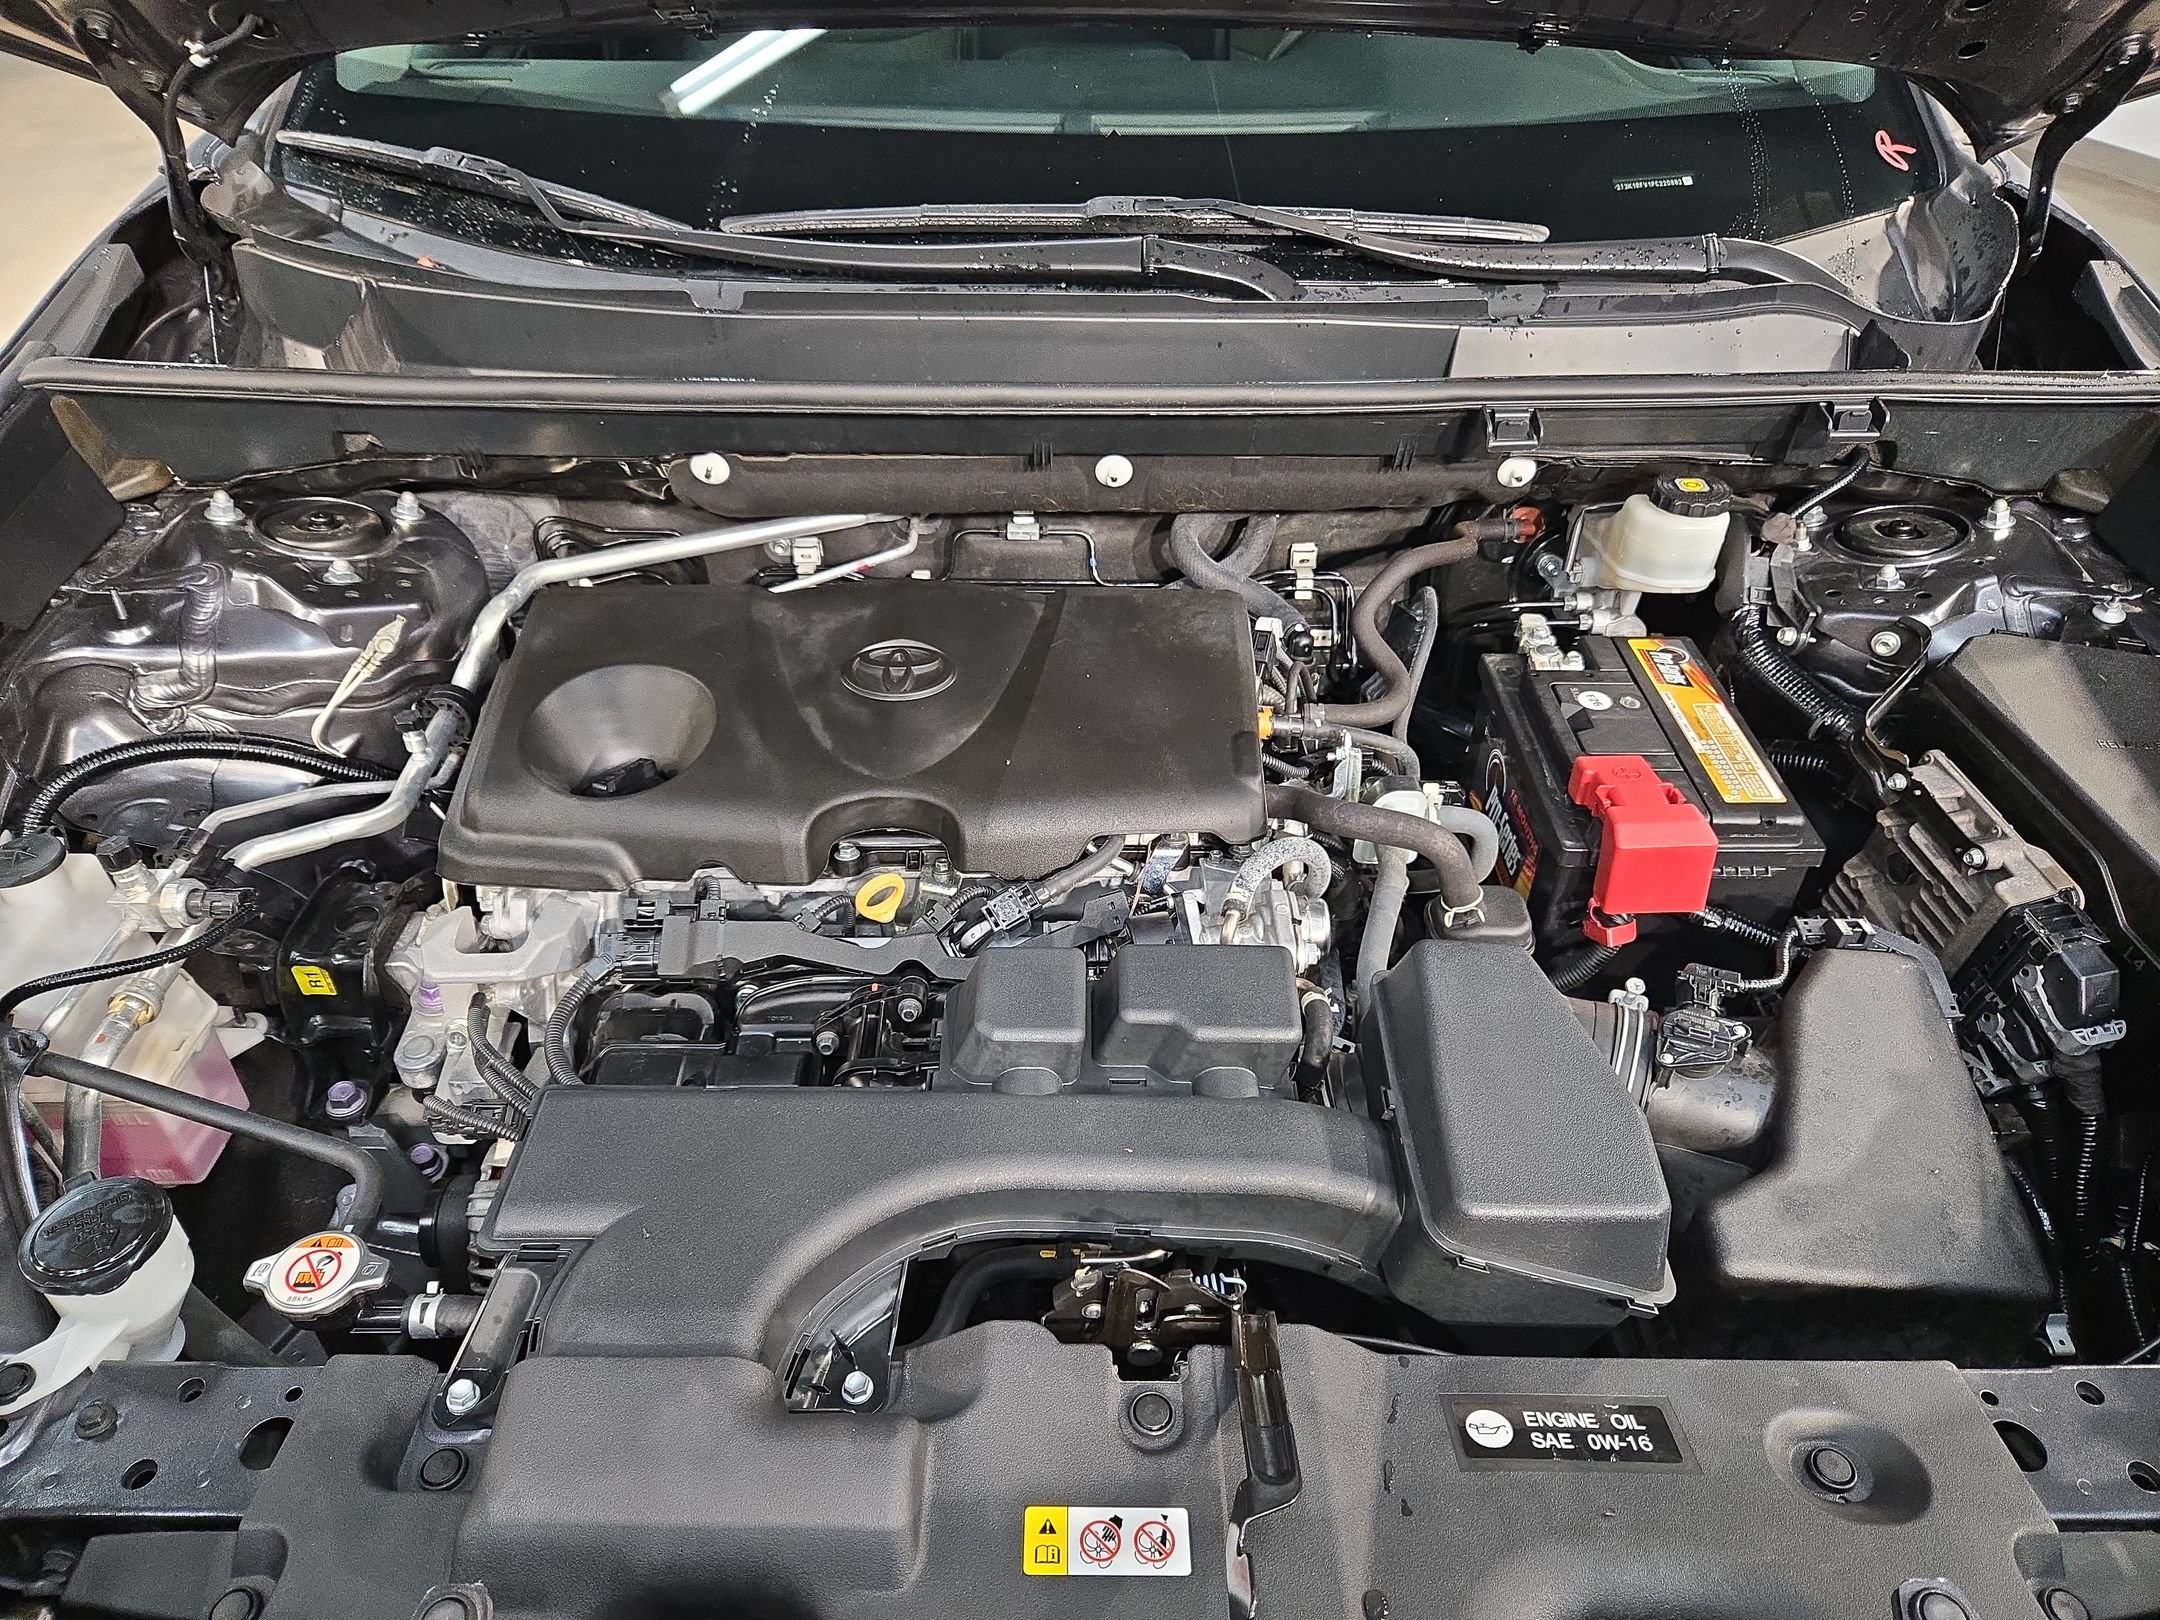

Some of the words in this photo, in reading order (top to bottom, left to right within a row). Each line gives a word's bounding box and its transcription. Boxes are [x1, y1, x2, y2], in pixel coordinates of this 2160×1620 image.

[1875, 129, 1917, 171] R
[1522, 1410, 1600, 1430] ENGINE
[1609, 1412, 1647, 1431] OIL
[1530, 1432, 1576, 1450] SAE
[1587, 1433, 1654, 1453] 0W-16
